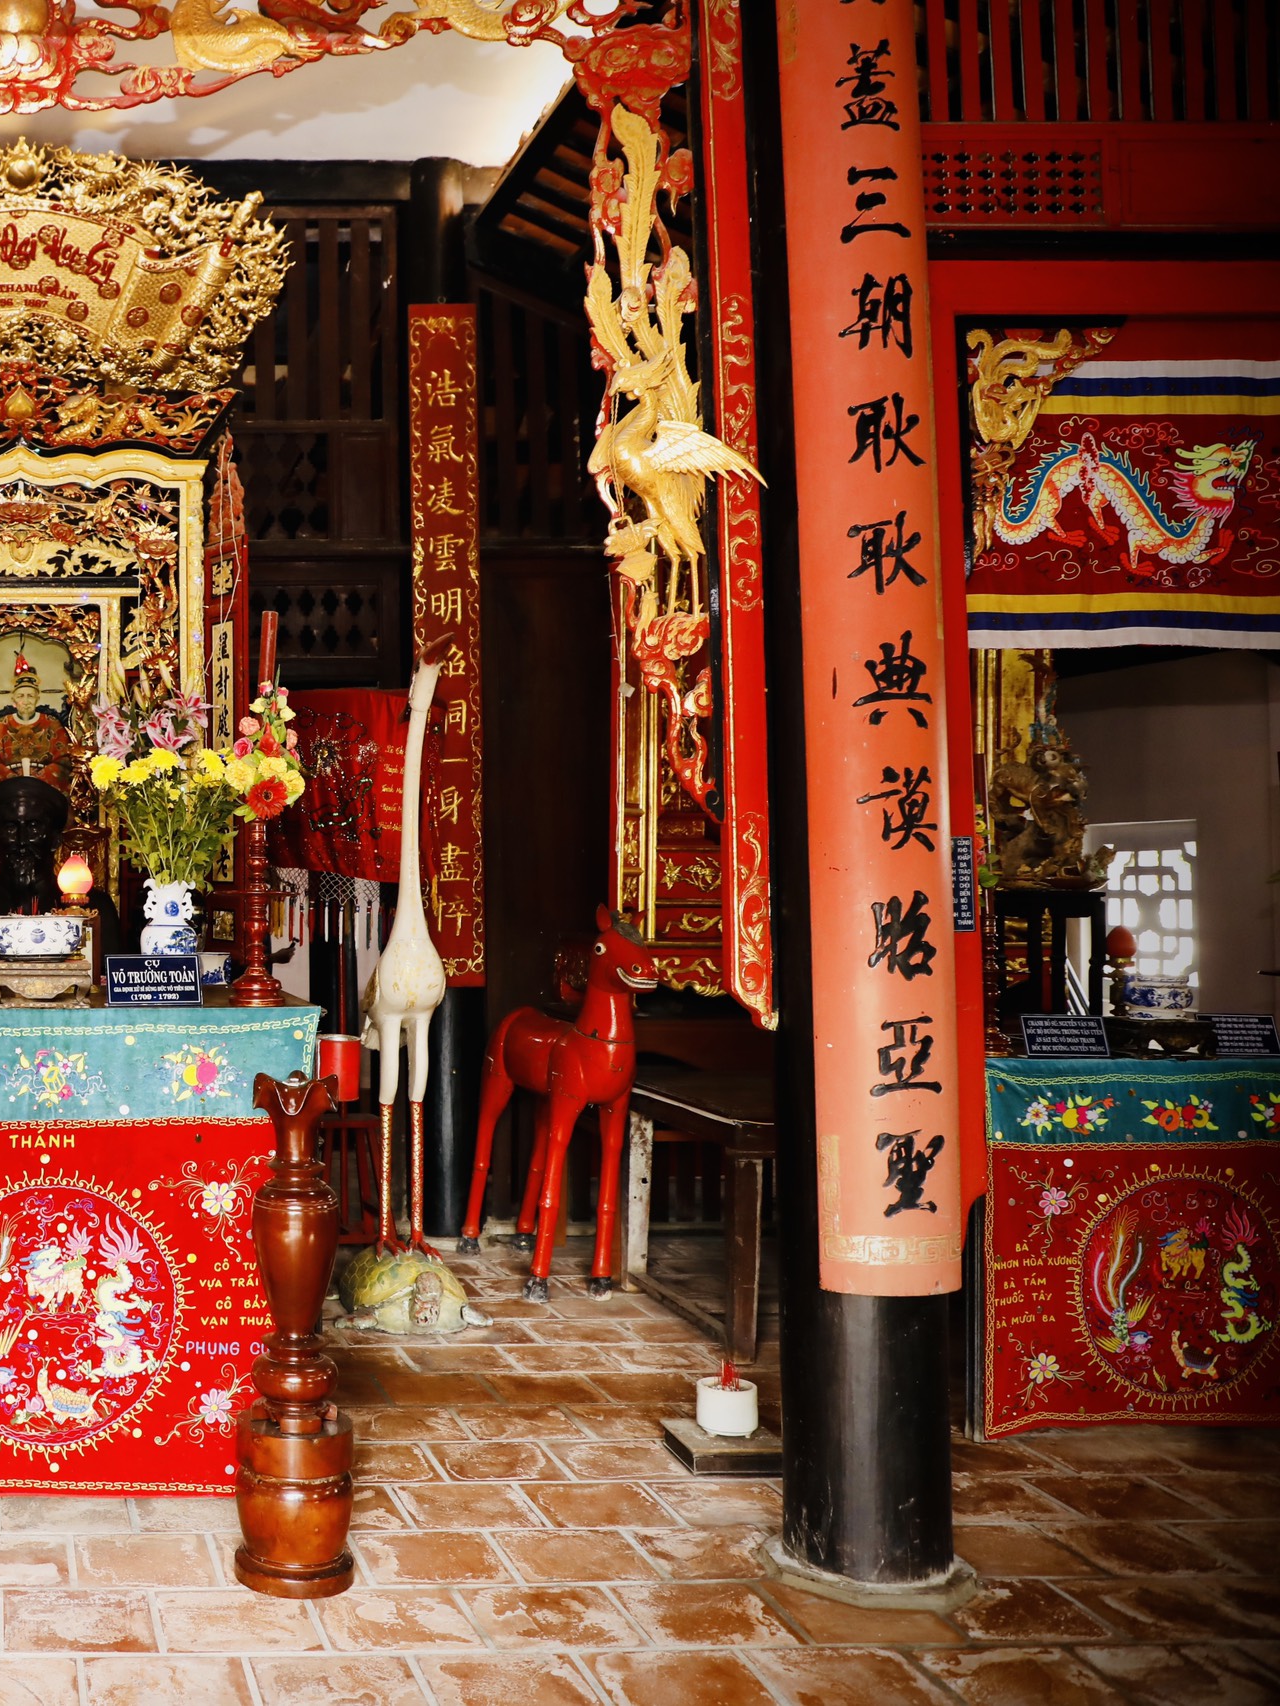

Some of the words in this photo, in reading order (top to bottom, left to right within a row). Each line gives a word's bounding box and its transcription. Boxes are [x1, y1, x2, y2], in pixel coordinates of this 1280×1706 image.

[0, 283, 41, 293] THANH
[144, 960, 161, 968] CỤ
[111, 968, 126, 984] VÕ
[127, 967, 167, 984] TRƯỜNG
[169, 966, 195, 983] TOẢN
[9, 1128, 75, 1149] THÁNH
[1015, 1239, 1029, 1252] BÀ
[214, 1258, 230, 1272] CÔ
[993, 1259, 1019, 1270] NHƠN
[1023, 1254, 1043, 1266] HÒA
[1047, 1256, 1077, 1266] XƯƠNG
[199, 1278, 223, 1291] VỰA
[230, 1273, 259, 1287] TRÁI
[1003, 1277, 1016, 1289] BÀ
[1023, 1272, 1047, 1286] TÁM
[216, 1296, 232, 1310] CÔ
[244, 1294, 267, 1309] BẢY
[994, 1290, 1024, 1307] THUỐC
[1031, 1290, 1052, 1301] TÂY
[200, 1316, 228, 1330] VẠN
[240, 1313, 276, 1329] THUẬ
[996, 1316, 1007, 1329] BÀ
[1011, 1311, 1035, 1325] MƯỜI
[1042, 1314, 1056, 1322] BA
[185, 1341, 240, 1360] PHỤNG
